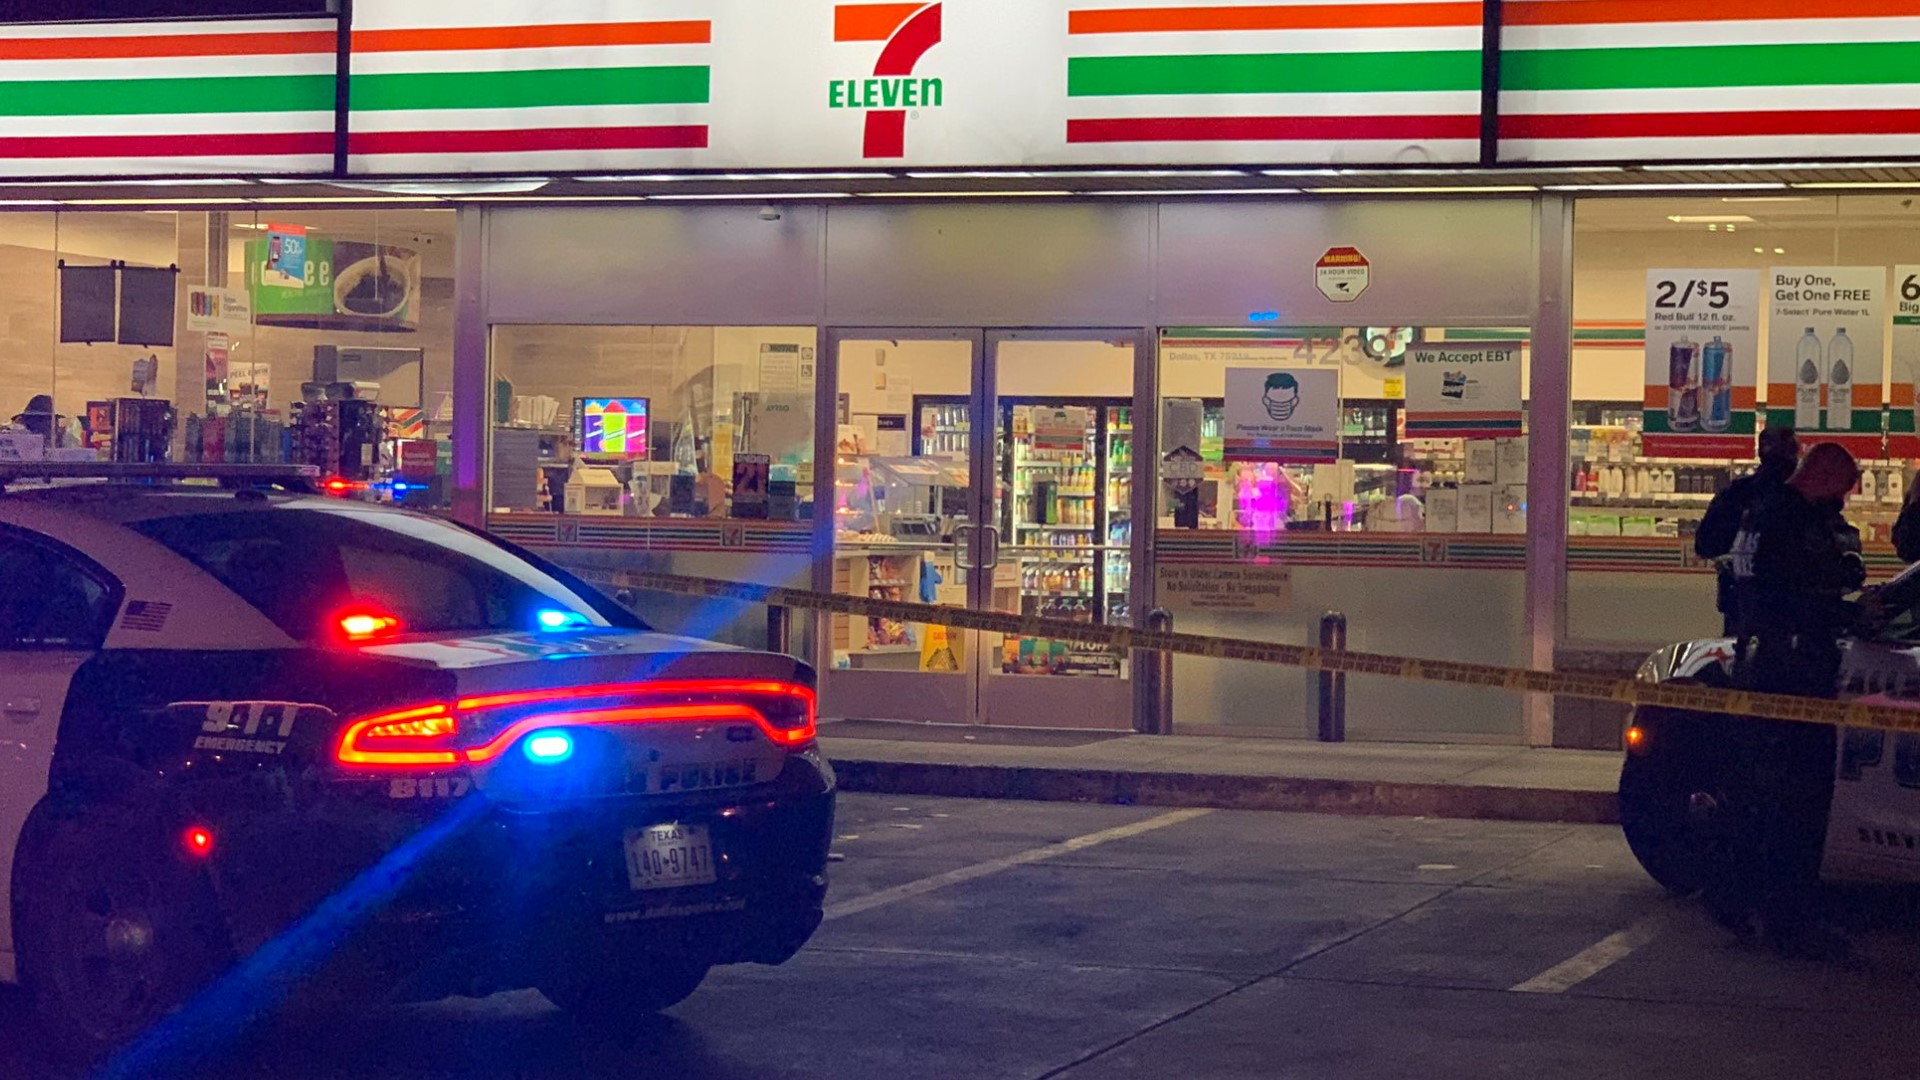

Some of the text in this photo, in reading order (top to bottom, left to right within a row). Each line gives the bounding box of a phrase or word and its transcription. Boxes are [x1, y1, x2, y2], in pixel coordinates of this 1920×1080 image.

[834, 2, 942, 158] 7
[1776, 274, 1836, 288] Buy One,
[1775, 289, 1871, 301] Get One FREE
[1776, 308, 1870, 316] 7-Select Pure Water 1L
[1899, 301, 1920, 314] Big
[1655, 312, 1674, 321] Red
[1676, 312, 1695, 321] Bull
[1698, 312, 1709, 321] 12
[1711, 312, 1720, 321] fl.
[1169, 351, 1201, 361] Dallas,
[1203, 351, 1217, 360] TX
[1293, 334, 1392, 366] 4239
[1414, 350, 1513, 365] We Accept EBT
[735, 454, 769, 463] UNDER
[1169, 462, 1199, 474] CBD
[1160, 567, 1180, 579] Store
[1166, 581, 1177, 592] No
[194, 736, 287, 755] EMERGENCY
[650, 830, 685, 842] TEXAS
